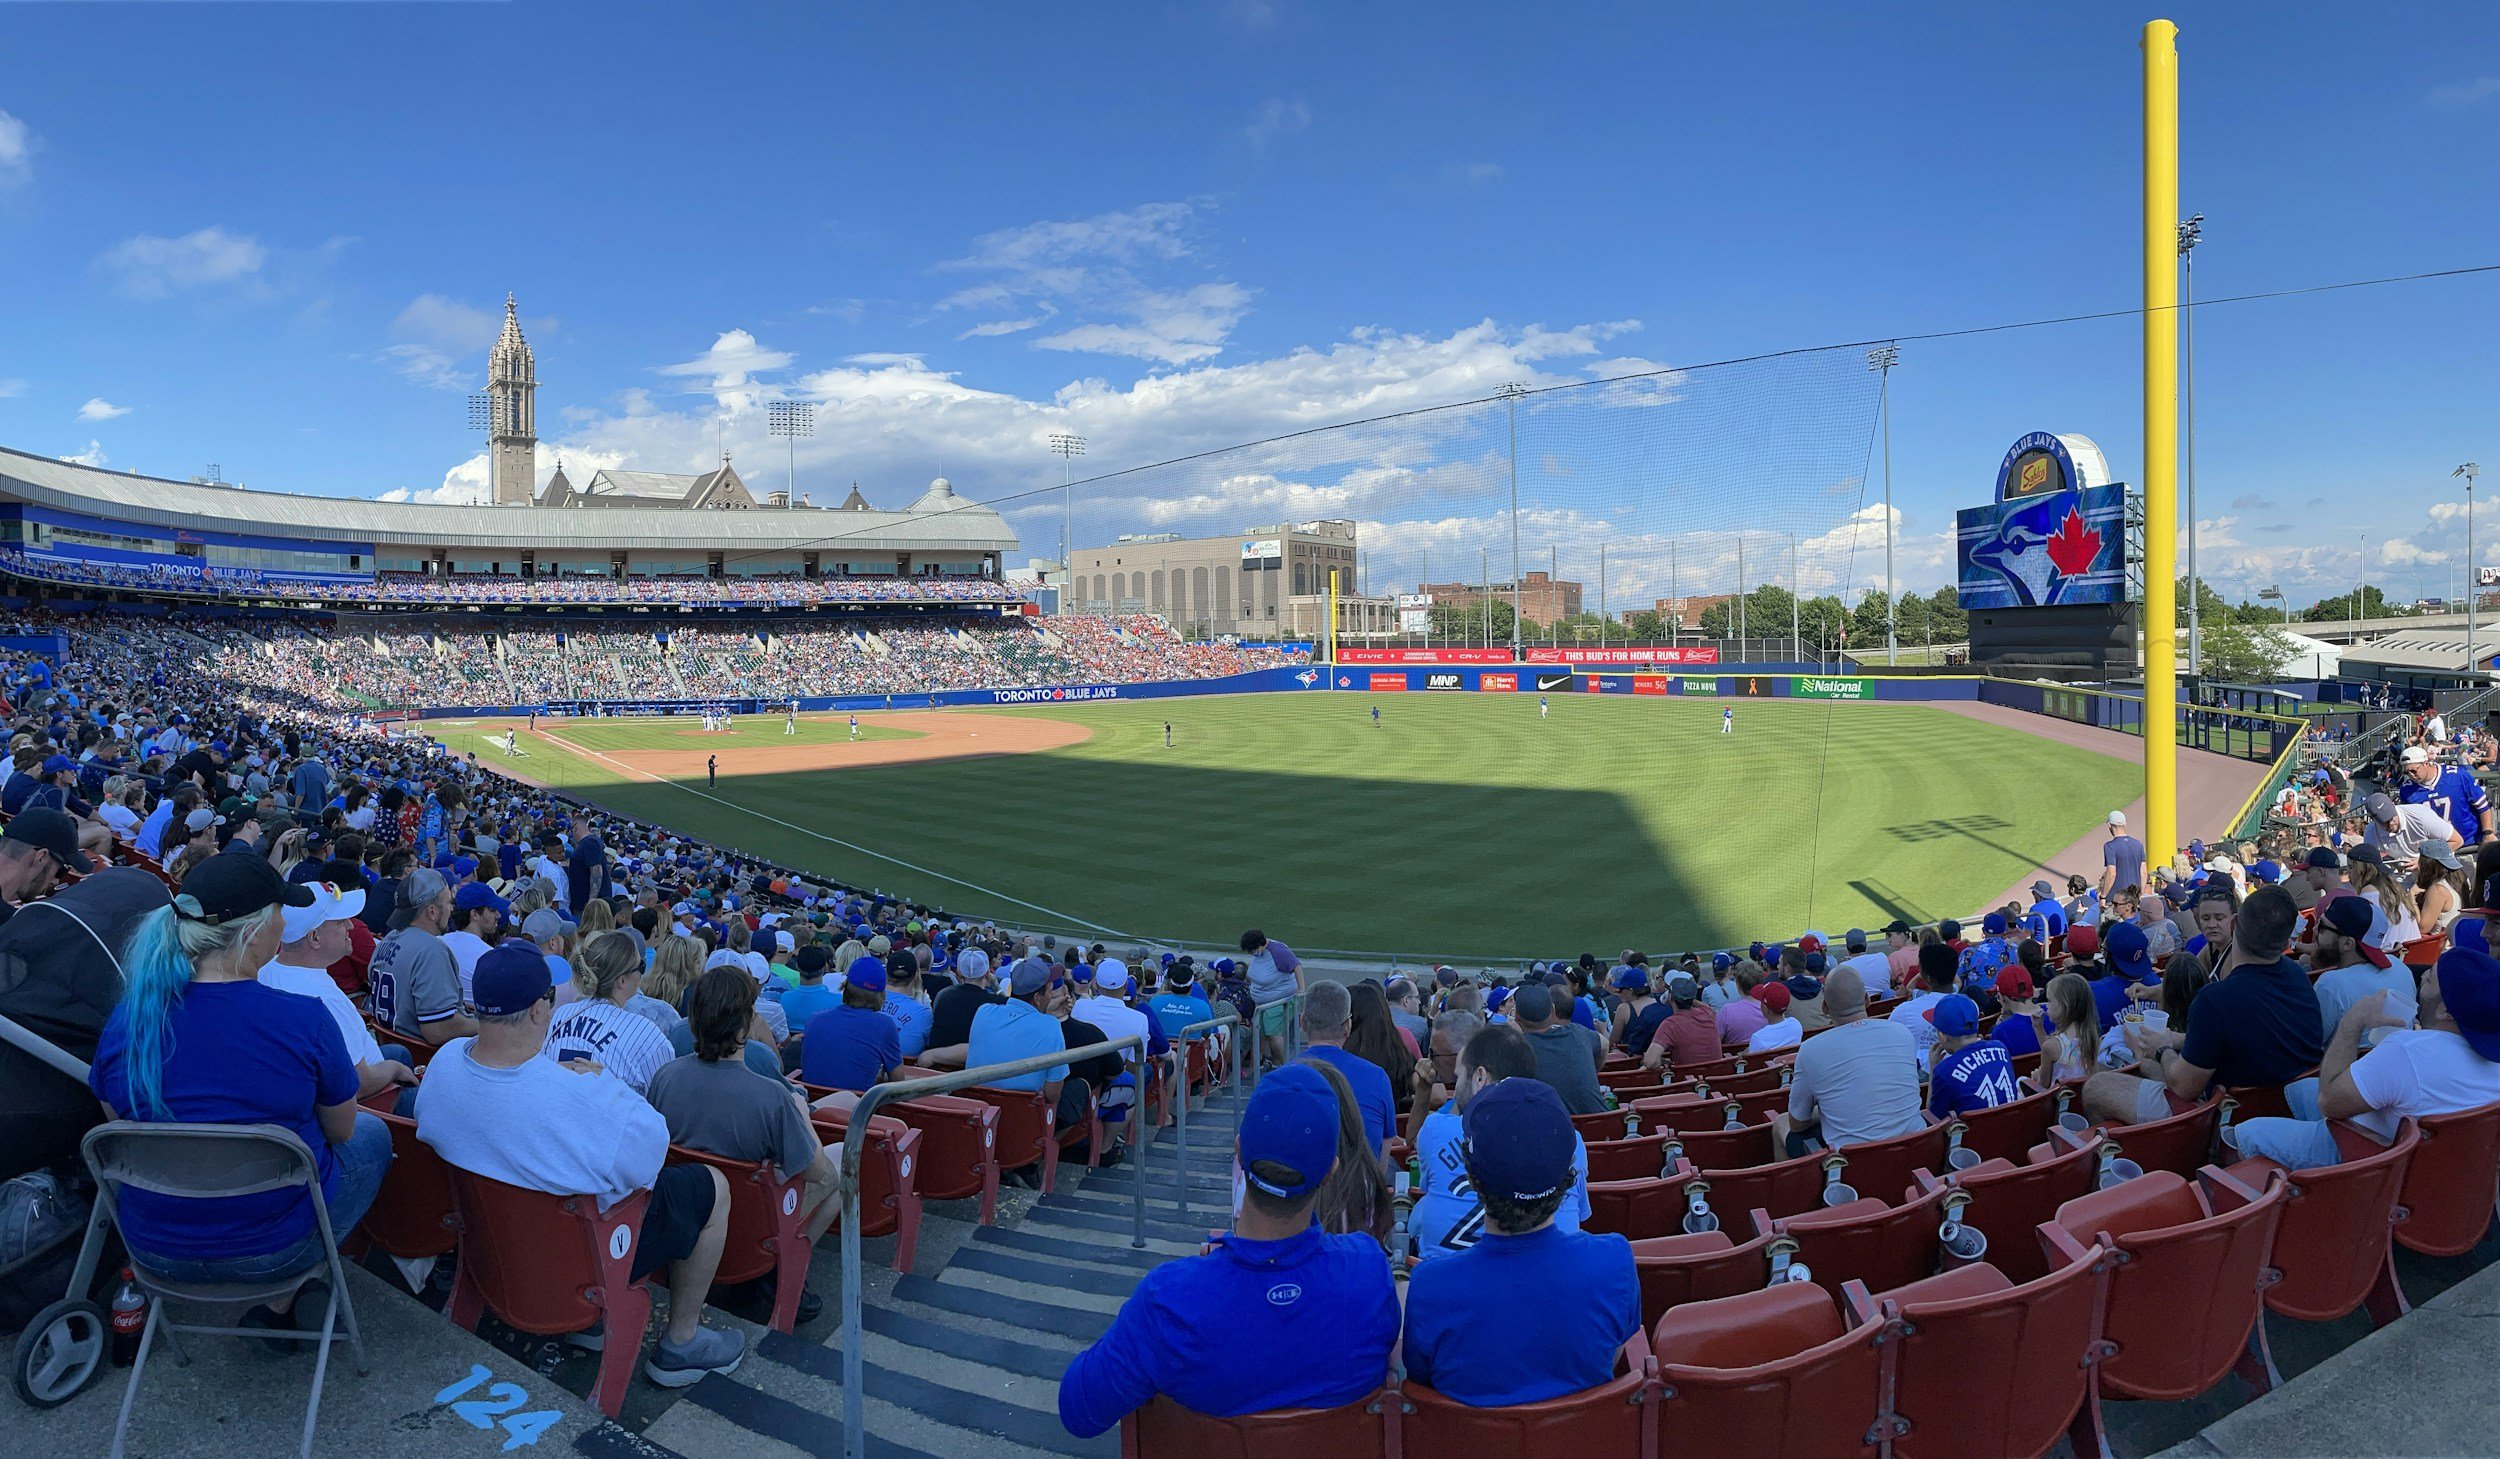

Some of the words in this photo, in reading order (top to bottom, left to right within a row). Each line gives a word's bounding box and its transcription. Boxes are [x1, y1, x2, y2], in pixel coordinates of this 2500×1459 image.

[2010, 436, 2032, 459] BLUE
[2034, 434, 2056, 450] JAYS
[151, 563, 200, 577] TORONTO
[213, 569, 237, 579] BLUE
[239, 570, 263, 581] JAYS
[1565, 652, 1584, 661] THIS
[1586, 652, 1611, 661] BUD'S
[1612, 652, 1628, 661] FOR
[1630, 651, 1655, 660] HOME
[1657, 651, 1680, 660] RUNS
[1430, 675, 1458, 686] MNP
[1655, 681, 1666, 690] 5G
[1684, 682, 1700, 691] PIZZA
[1701, 682, 1717, 692] NOVA
[993, 690, 1051, 702] TORONTO
[1065, 688, 1091, 699] BLUE
[1091, 687, 1117, 698] JAYS
[2275, 722, 2287, 734] 371
[2446, 765, 2458, 774] 17
[551, 1015, 618, 1053] MANTLE
[1951, 1047, 2008, 1083] BICHETTE
[1974, 1066, 2015, 1108] 11
[1513, 1186, 1557, 1201] TORONTO
